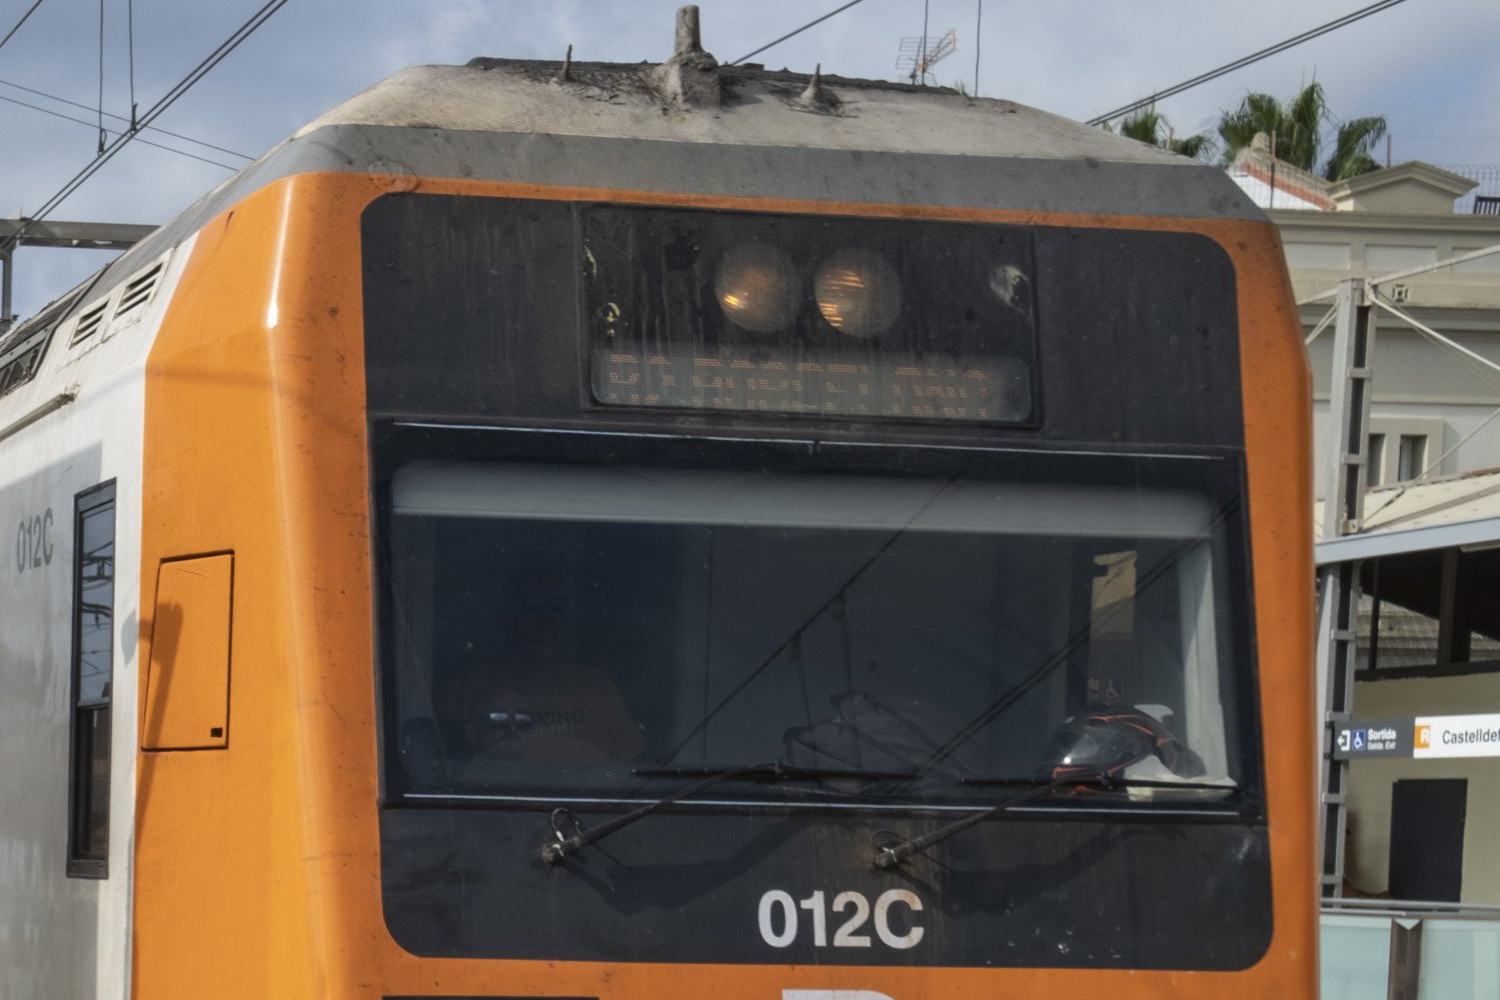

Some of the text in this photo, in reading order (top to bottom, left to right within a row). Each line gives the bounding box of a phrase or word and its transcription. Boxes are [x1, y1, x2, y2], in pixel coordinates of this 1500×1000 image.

[17, 507, 54, 573] 012C
[1367, 728, 1396, 740] Sortida
[758, 889, 925, 949] 012C
